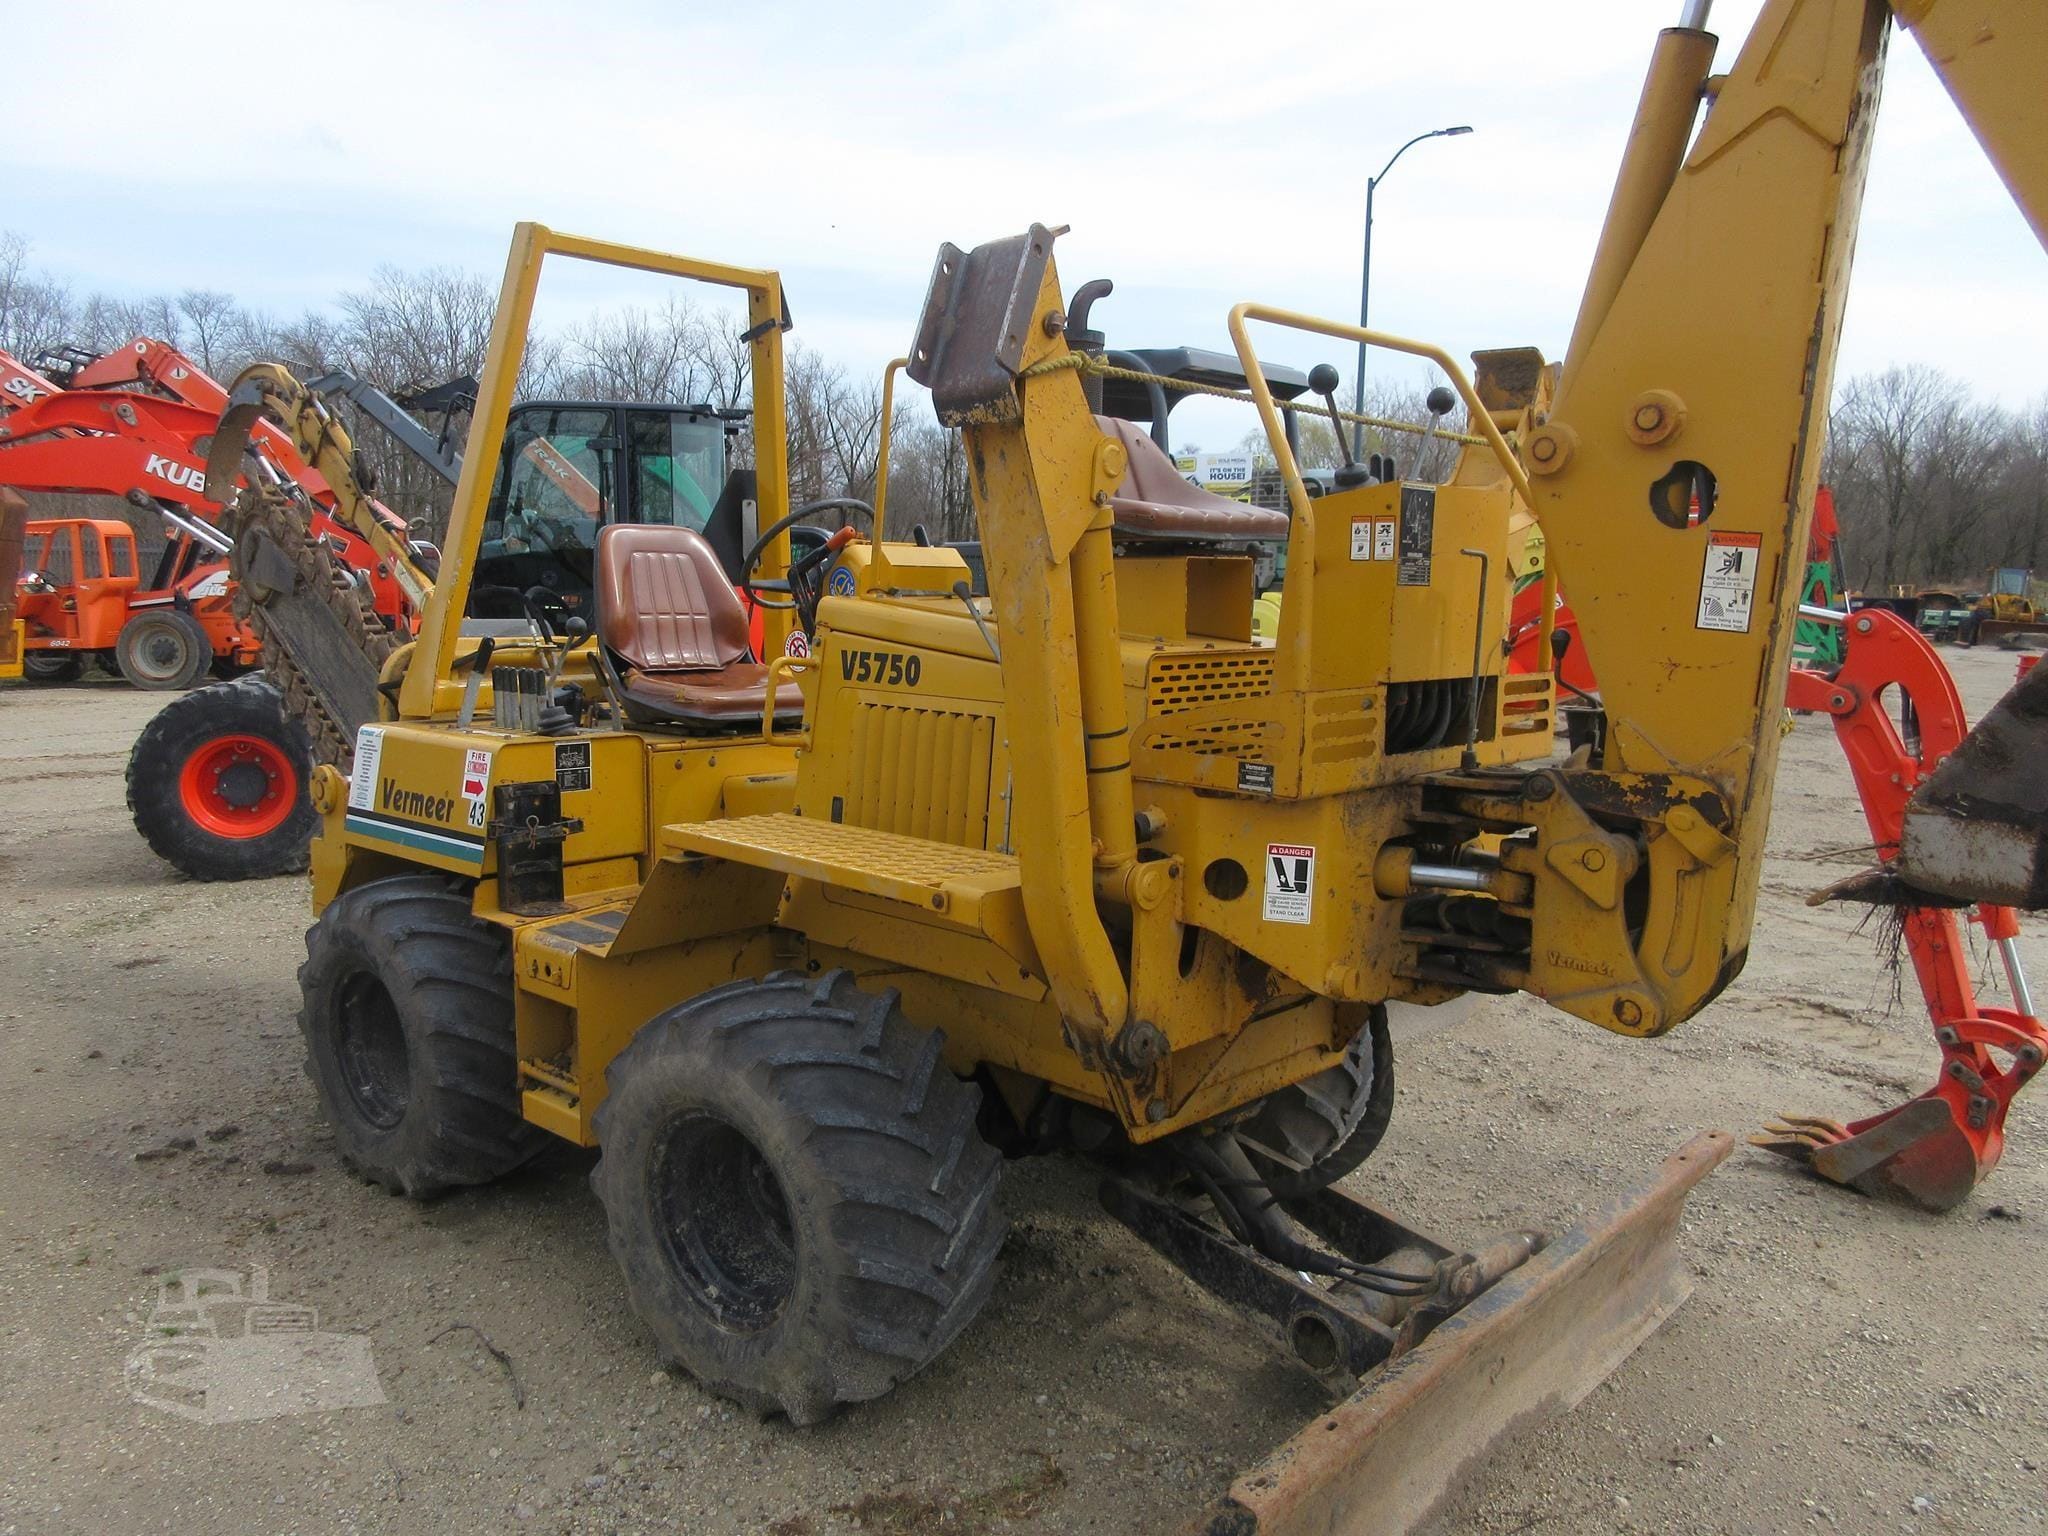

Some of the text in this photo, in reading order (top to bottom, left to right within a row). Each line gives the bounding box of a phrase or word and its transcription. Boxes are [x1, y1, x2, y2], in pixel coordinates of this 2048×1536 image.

[3, 376, 49, 405] SK
[840, 649, 921, 687] V5750
[471, 751, 487, 762] FIRE
[383, 777, 455, 823] Vermeer
[469, 801, 485, 826] 43
[1278, 847, 1311, 856] DANGER
